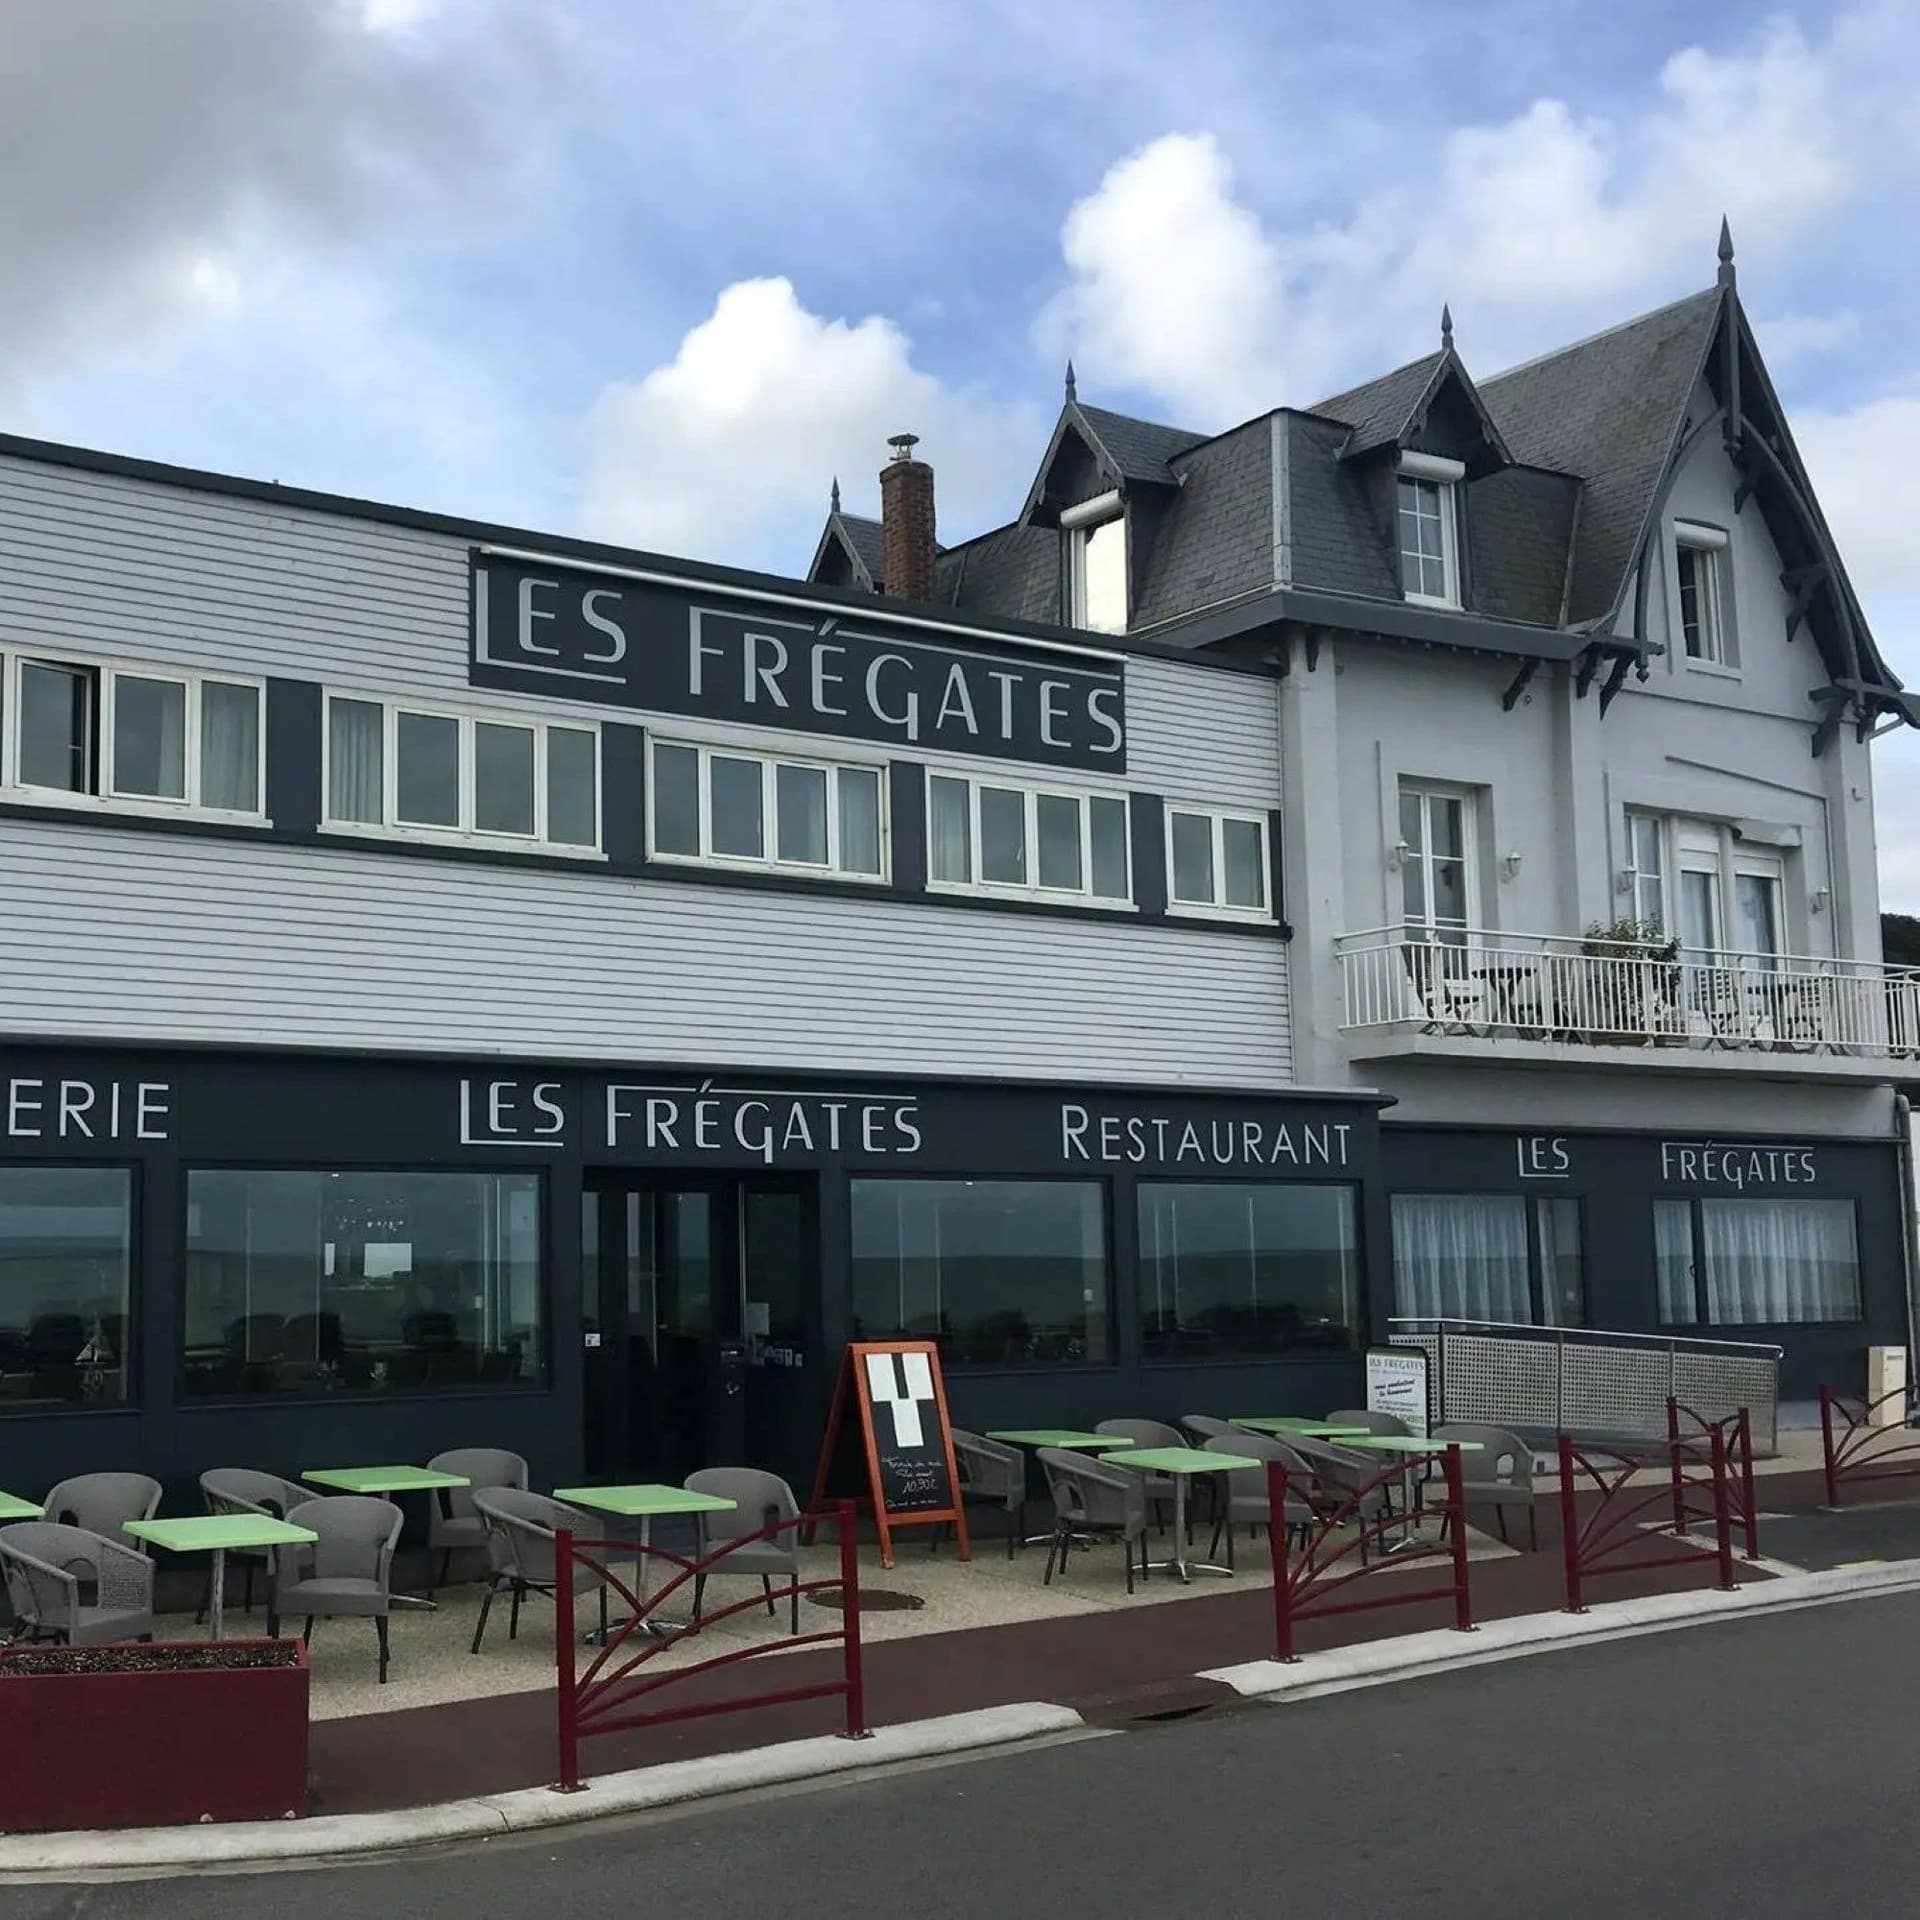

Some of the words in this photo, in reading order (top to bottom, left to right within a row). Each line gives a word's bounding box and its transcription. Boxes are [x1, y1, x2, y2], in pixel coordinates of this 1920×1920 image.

[475, 567, 627, 684] LES
[689, 605, 1122, 753] FRÉGATES
[460, 1079, 565, 1147] LES
[606, 1078, 922, 1164] FRÉGATES
[1061, 1104, 1351, 1165] RESTAURANT
[1516, 1137, 1570, 1179] LES
[1661, 1140, 1816, 1190] FRÉGATES
